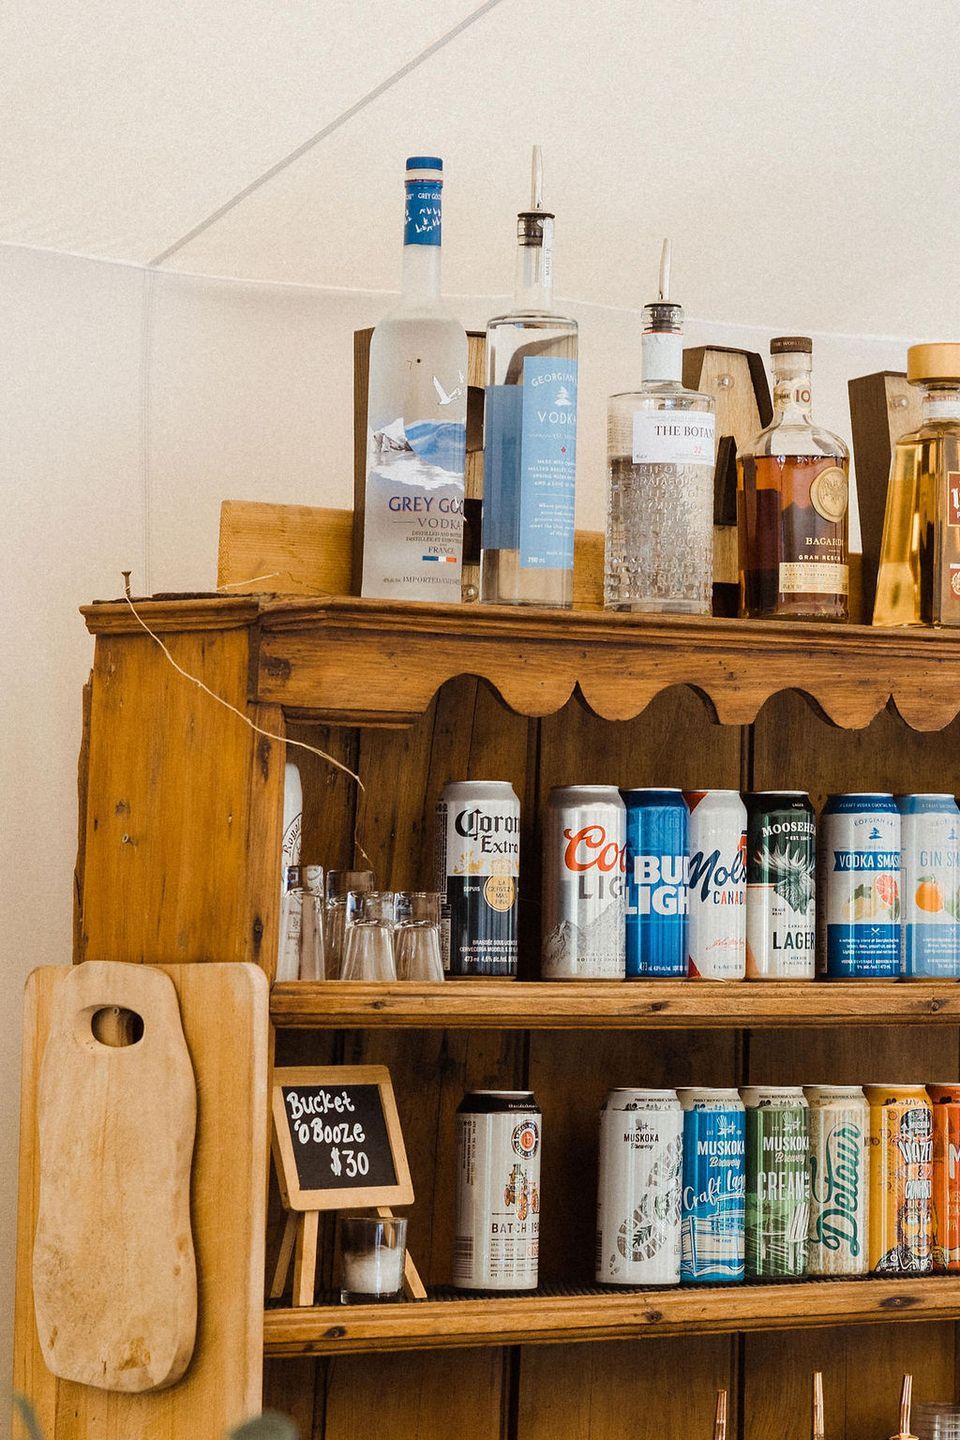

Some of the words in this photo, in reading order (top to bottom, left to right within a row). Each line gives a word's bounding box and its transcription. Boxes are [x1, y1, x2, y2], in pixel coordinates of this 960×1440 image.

[795, 389, 811, 402] 10
[654, 425, 680, 436] THE
[389, 497, 433, 511] GREY
[839, 855, 875, 868] VODKA
[920, 851, 942, 866] GIN
[286, 1089, 355, 1119] Bucket
[310, 1117, 366, 1144] Booze
[623, 1133, 659, 1142] MUSKOKA
[330, 1147, 370, 1177] $30
[709, 1156, 741, 1168] Brewery
[775, 1151, 806, 1164] Brewery
[757, 1171, 805, 1201] CREAM
[809, 1121, 862, 1257] Detour
[683, 1178, 721, 1211] Craft
[491, 1222, 527, 1234] BATCH
